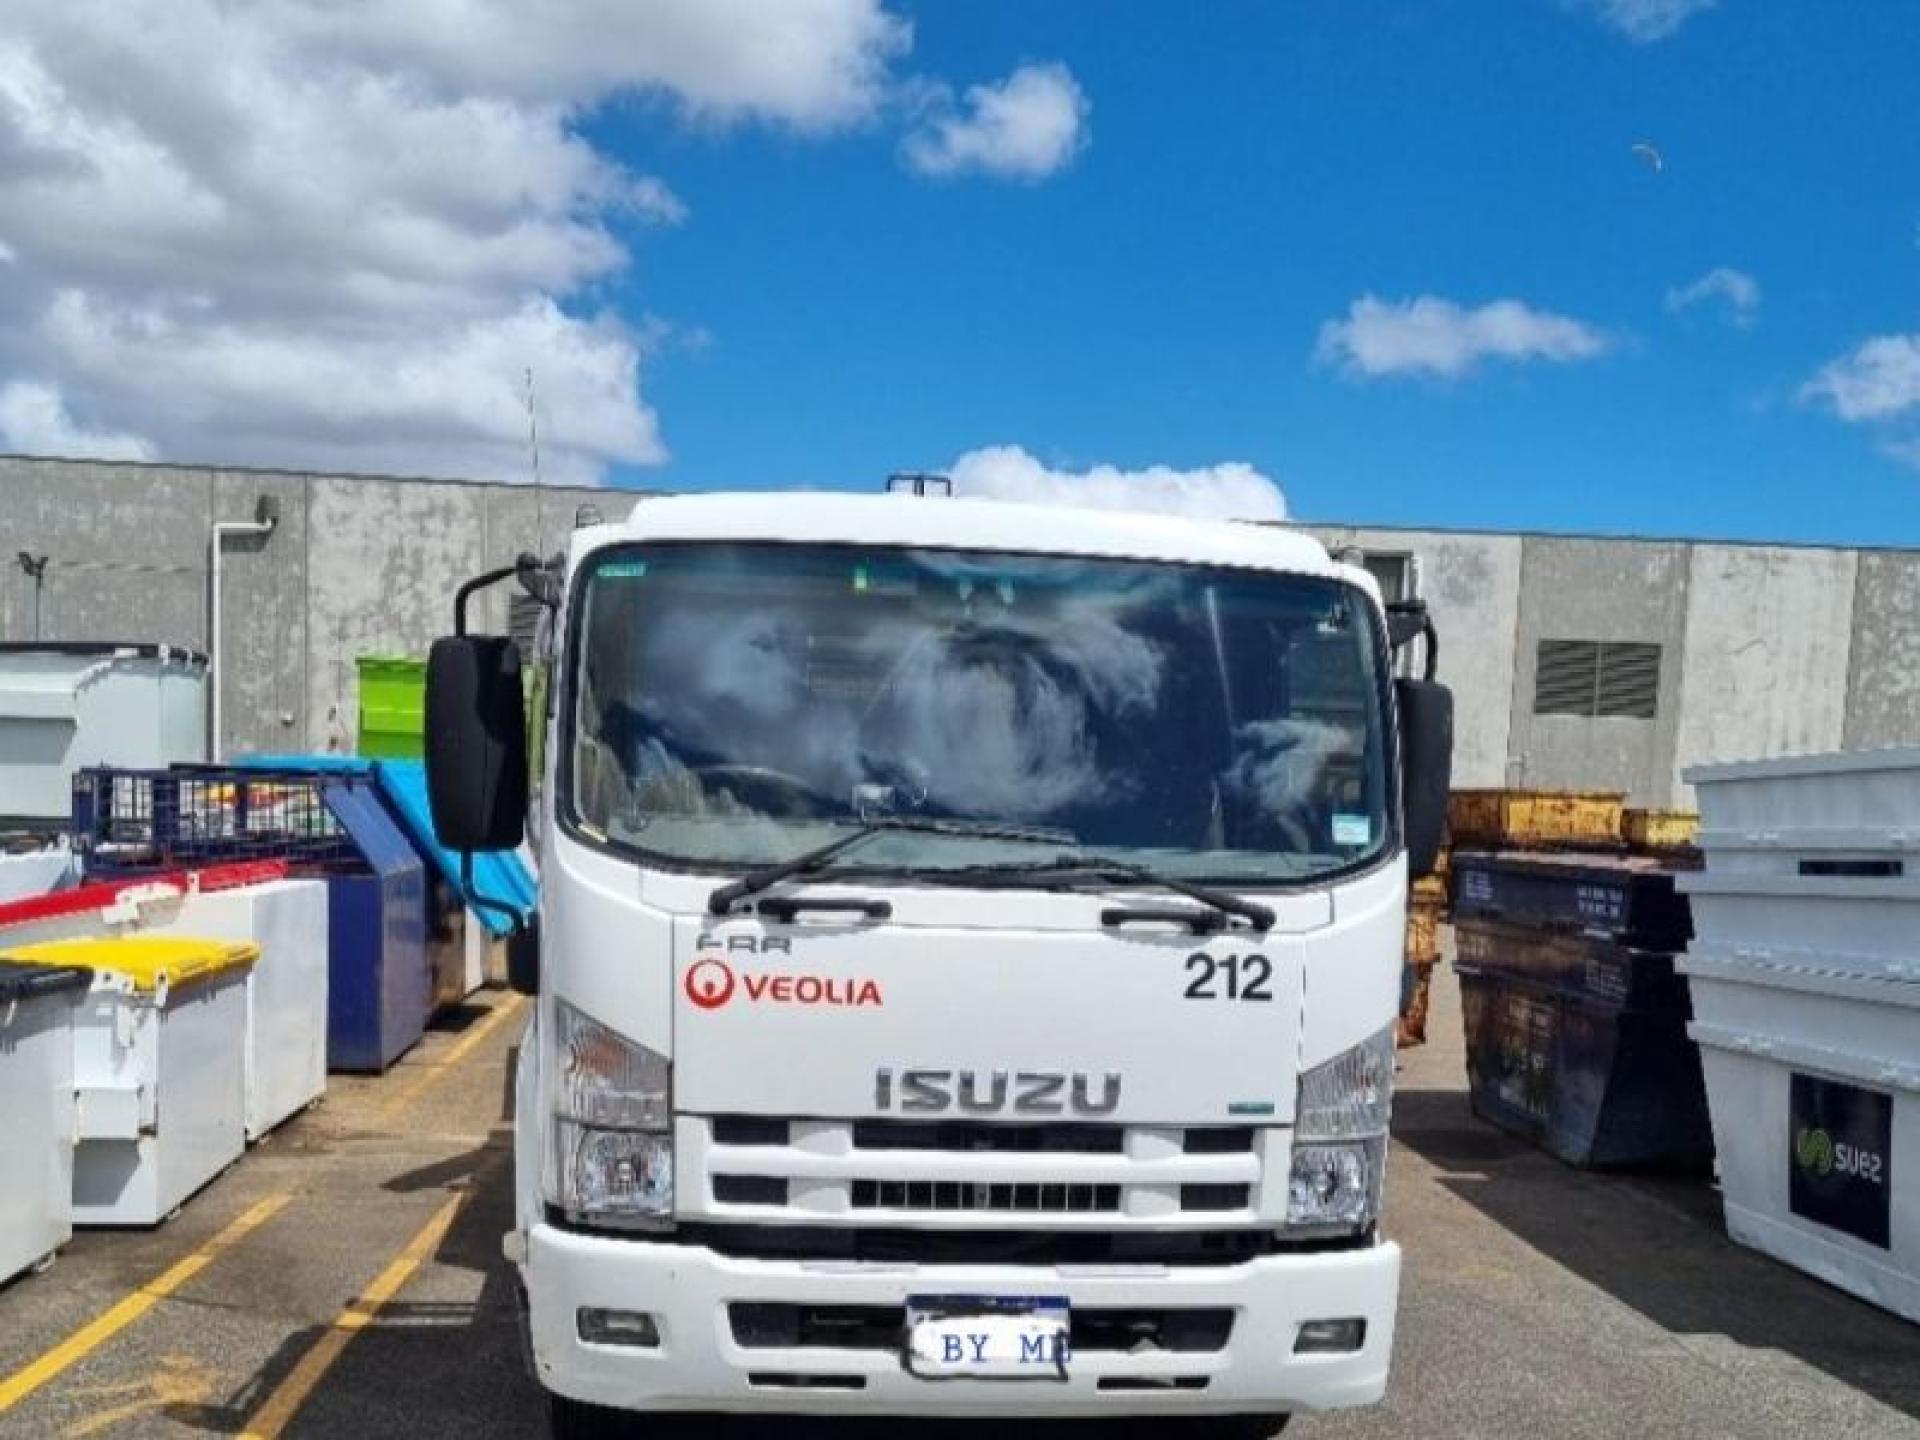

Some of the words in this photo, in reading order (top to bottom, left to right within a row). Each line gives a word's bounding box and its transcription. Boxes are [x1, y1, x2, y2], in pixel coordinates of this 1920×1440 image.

[743, 974, 884, 1006] VEOLIA
[1183, 952, 1272, 1001] 212
[875, 1067, 1121, 1116] ISUZU
[941, 1334, 989, 1362] BY
